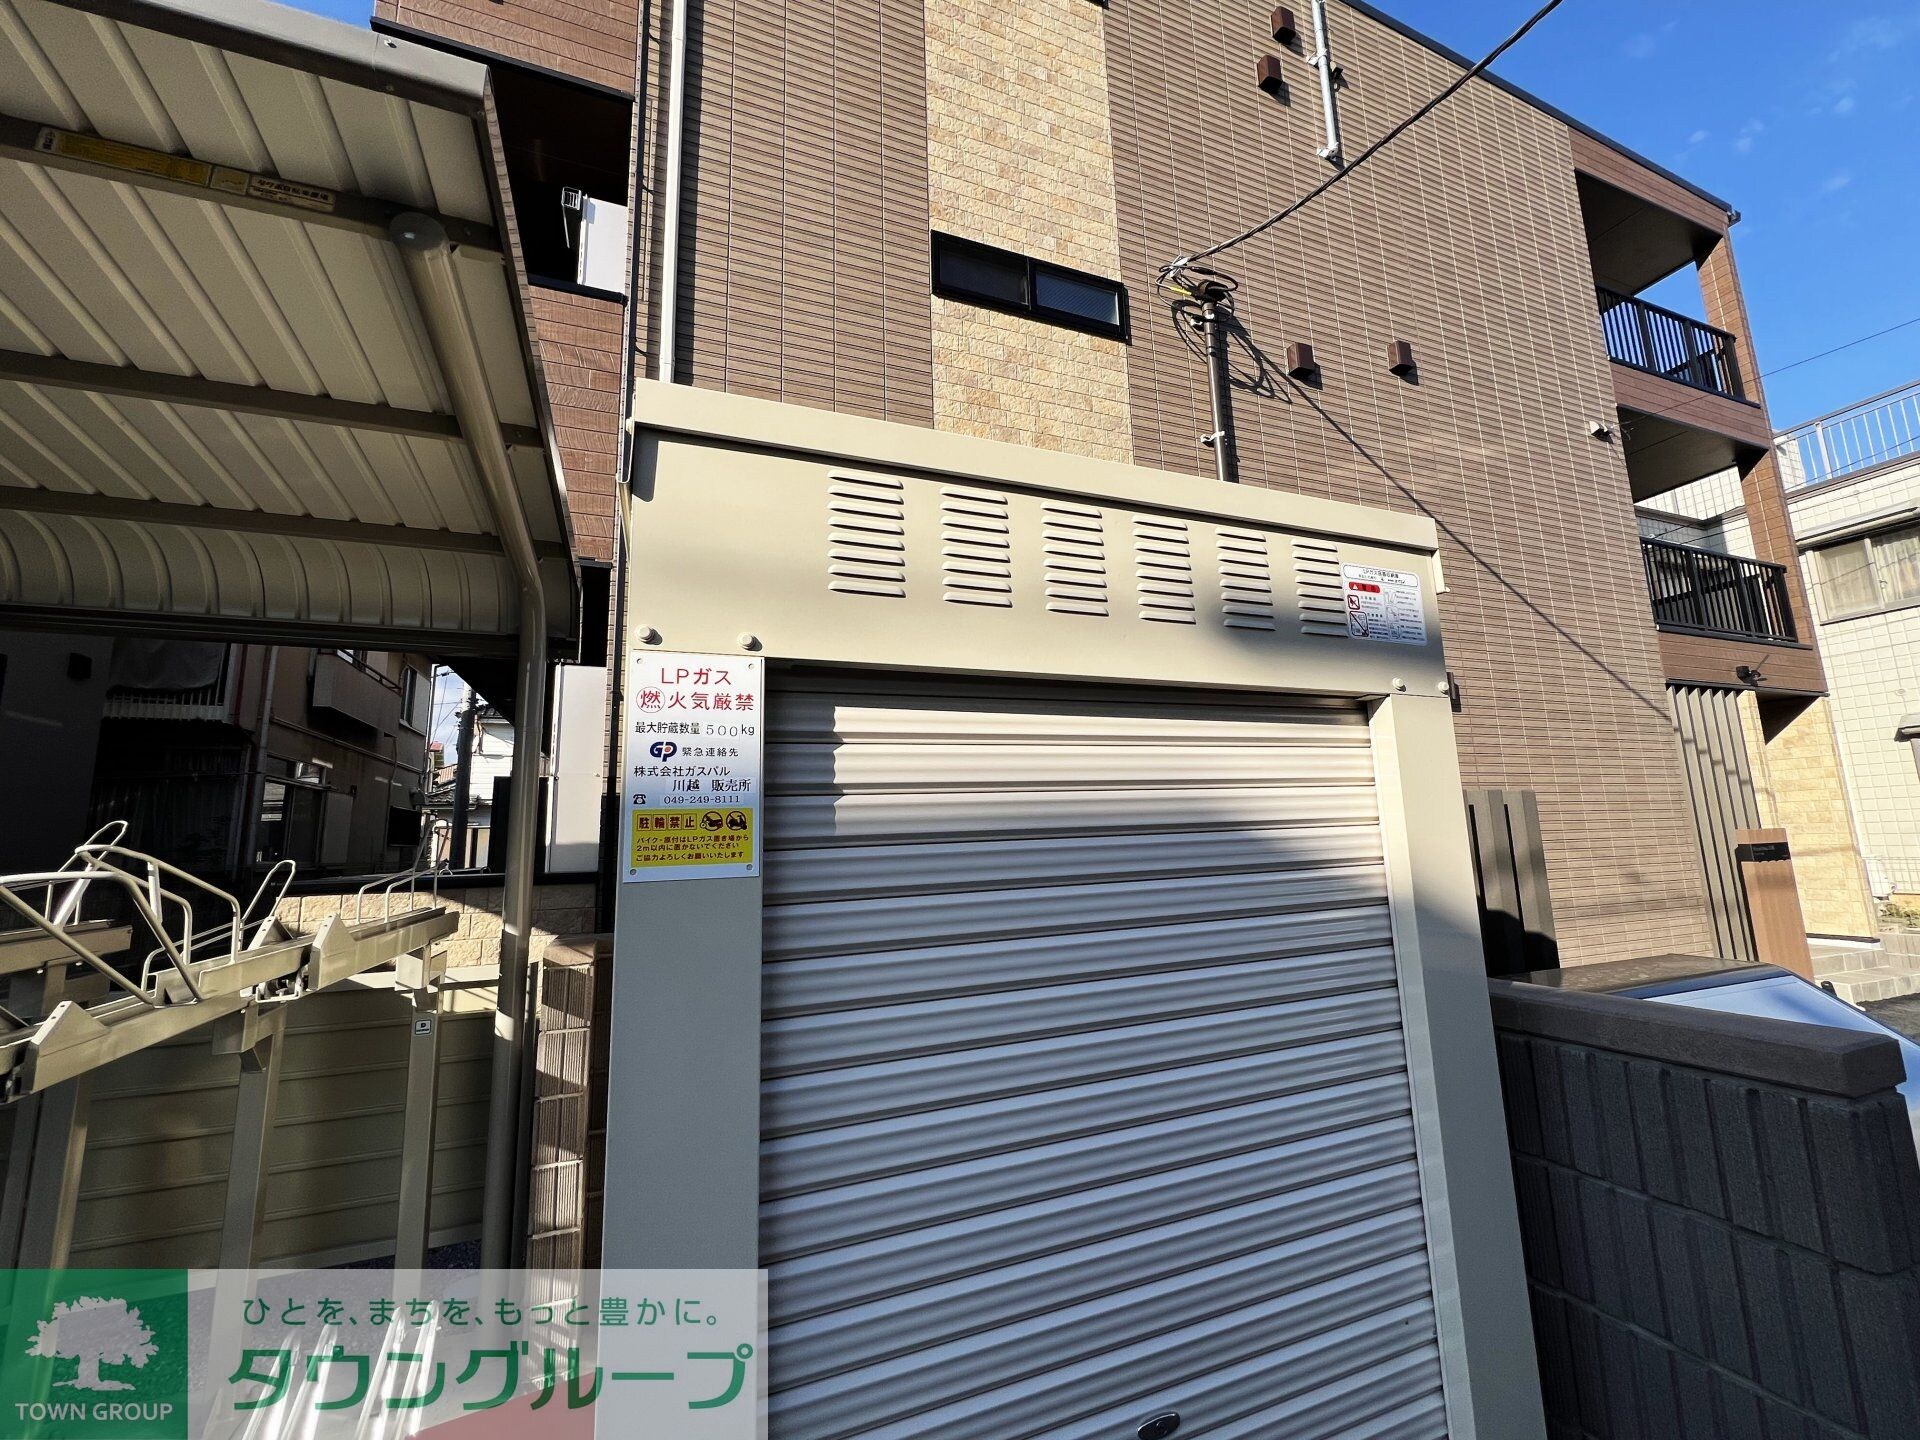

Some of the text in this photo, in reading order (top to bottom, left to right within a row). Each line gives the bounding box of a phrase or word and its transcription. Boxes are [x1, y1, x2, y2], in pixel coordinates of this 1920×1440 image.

[661, 667, 732, 686] LPガス
[668, 691, 754, 711] 火気厳禁
[635, 721, 701, 735] 最大貯蔵数量
[682, 747, 739, 757] 緊急連絡先
[633, 765, 730, 777] 株式会社ガスパル
[672, 778, 751, 792] 川越 販売所
[663, 795, 740, 804] 049-249-8111
[638, 814, 696, 830] 駐輪禁止
